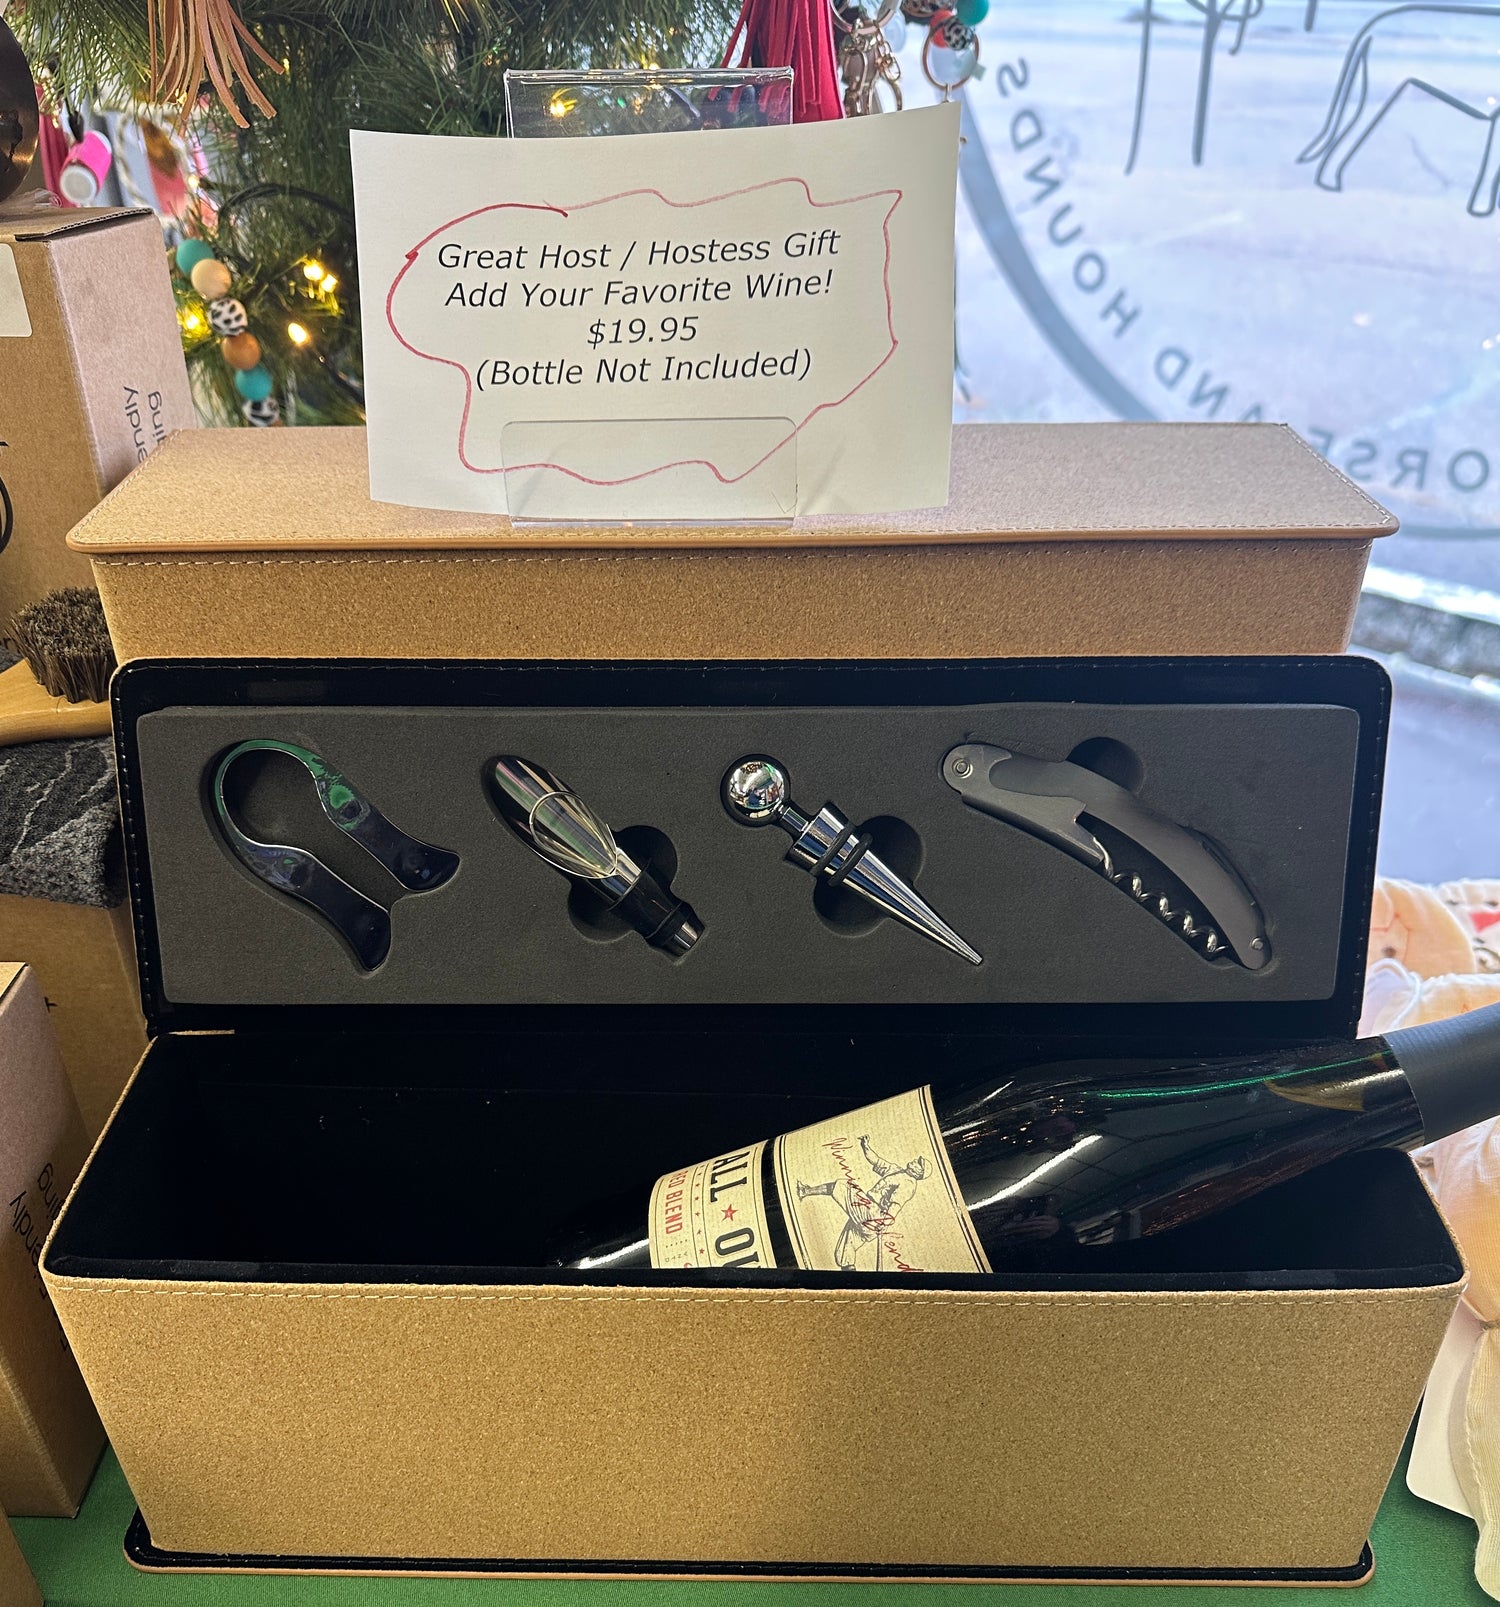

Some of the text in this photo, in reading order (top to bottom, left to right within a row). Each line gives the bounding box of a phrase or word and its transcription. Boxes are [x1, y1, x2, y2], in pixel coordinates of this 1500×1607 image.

[438, 229, 841, 272] Great Host / Hostess Gift
[444, 268, 834, 308] Add Your Favorite Wine!
[587, 315, 699, 350] $19.95
[476, 348, 812, 392] (Bottle Not Included)
[709, 1150, 751, 1203] ALL
[664, 1189, 684, 1235] BLEND
